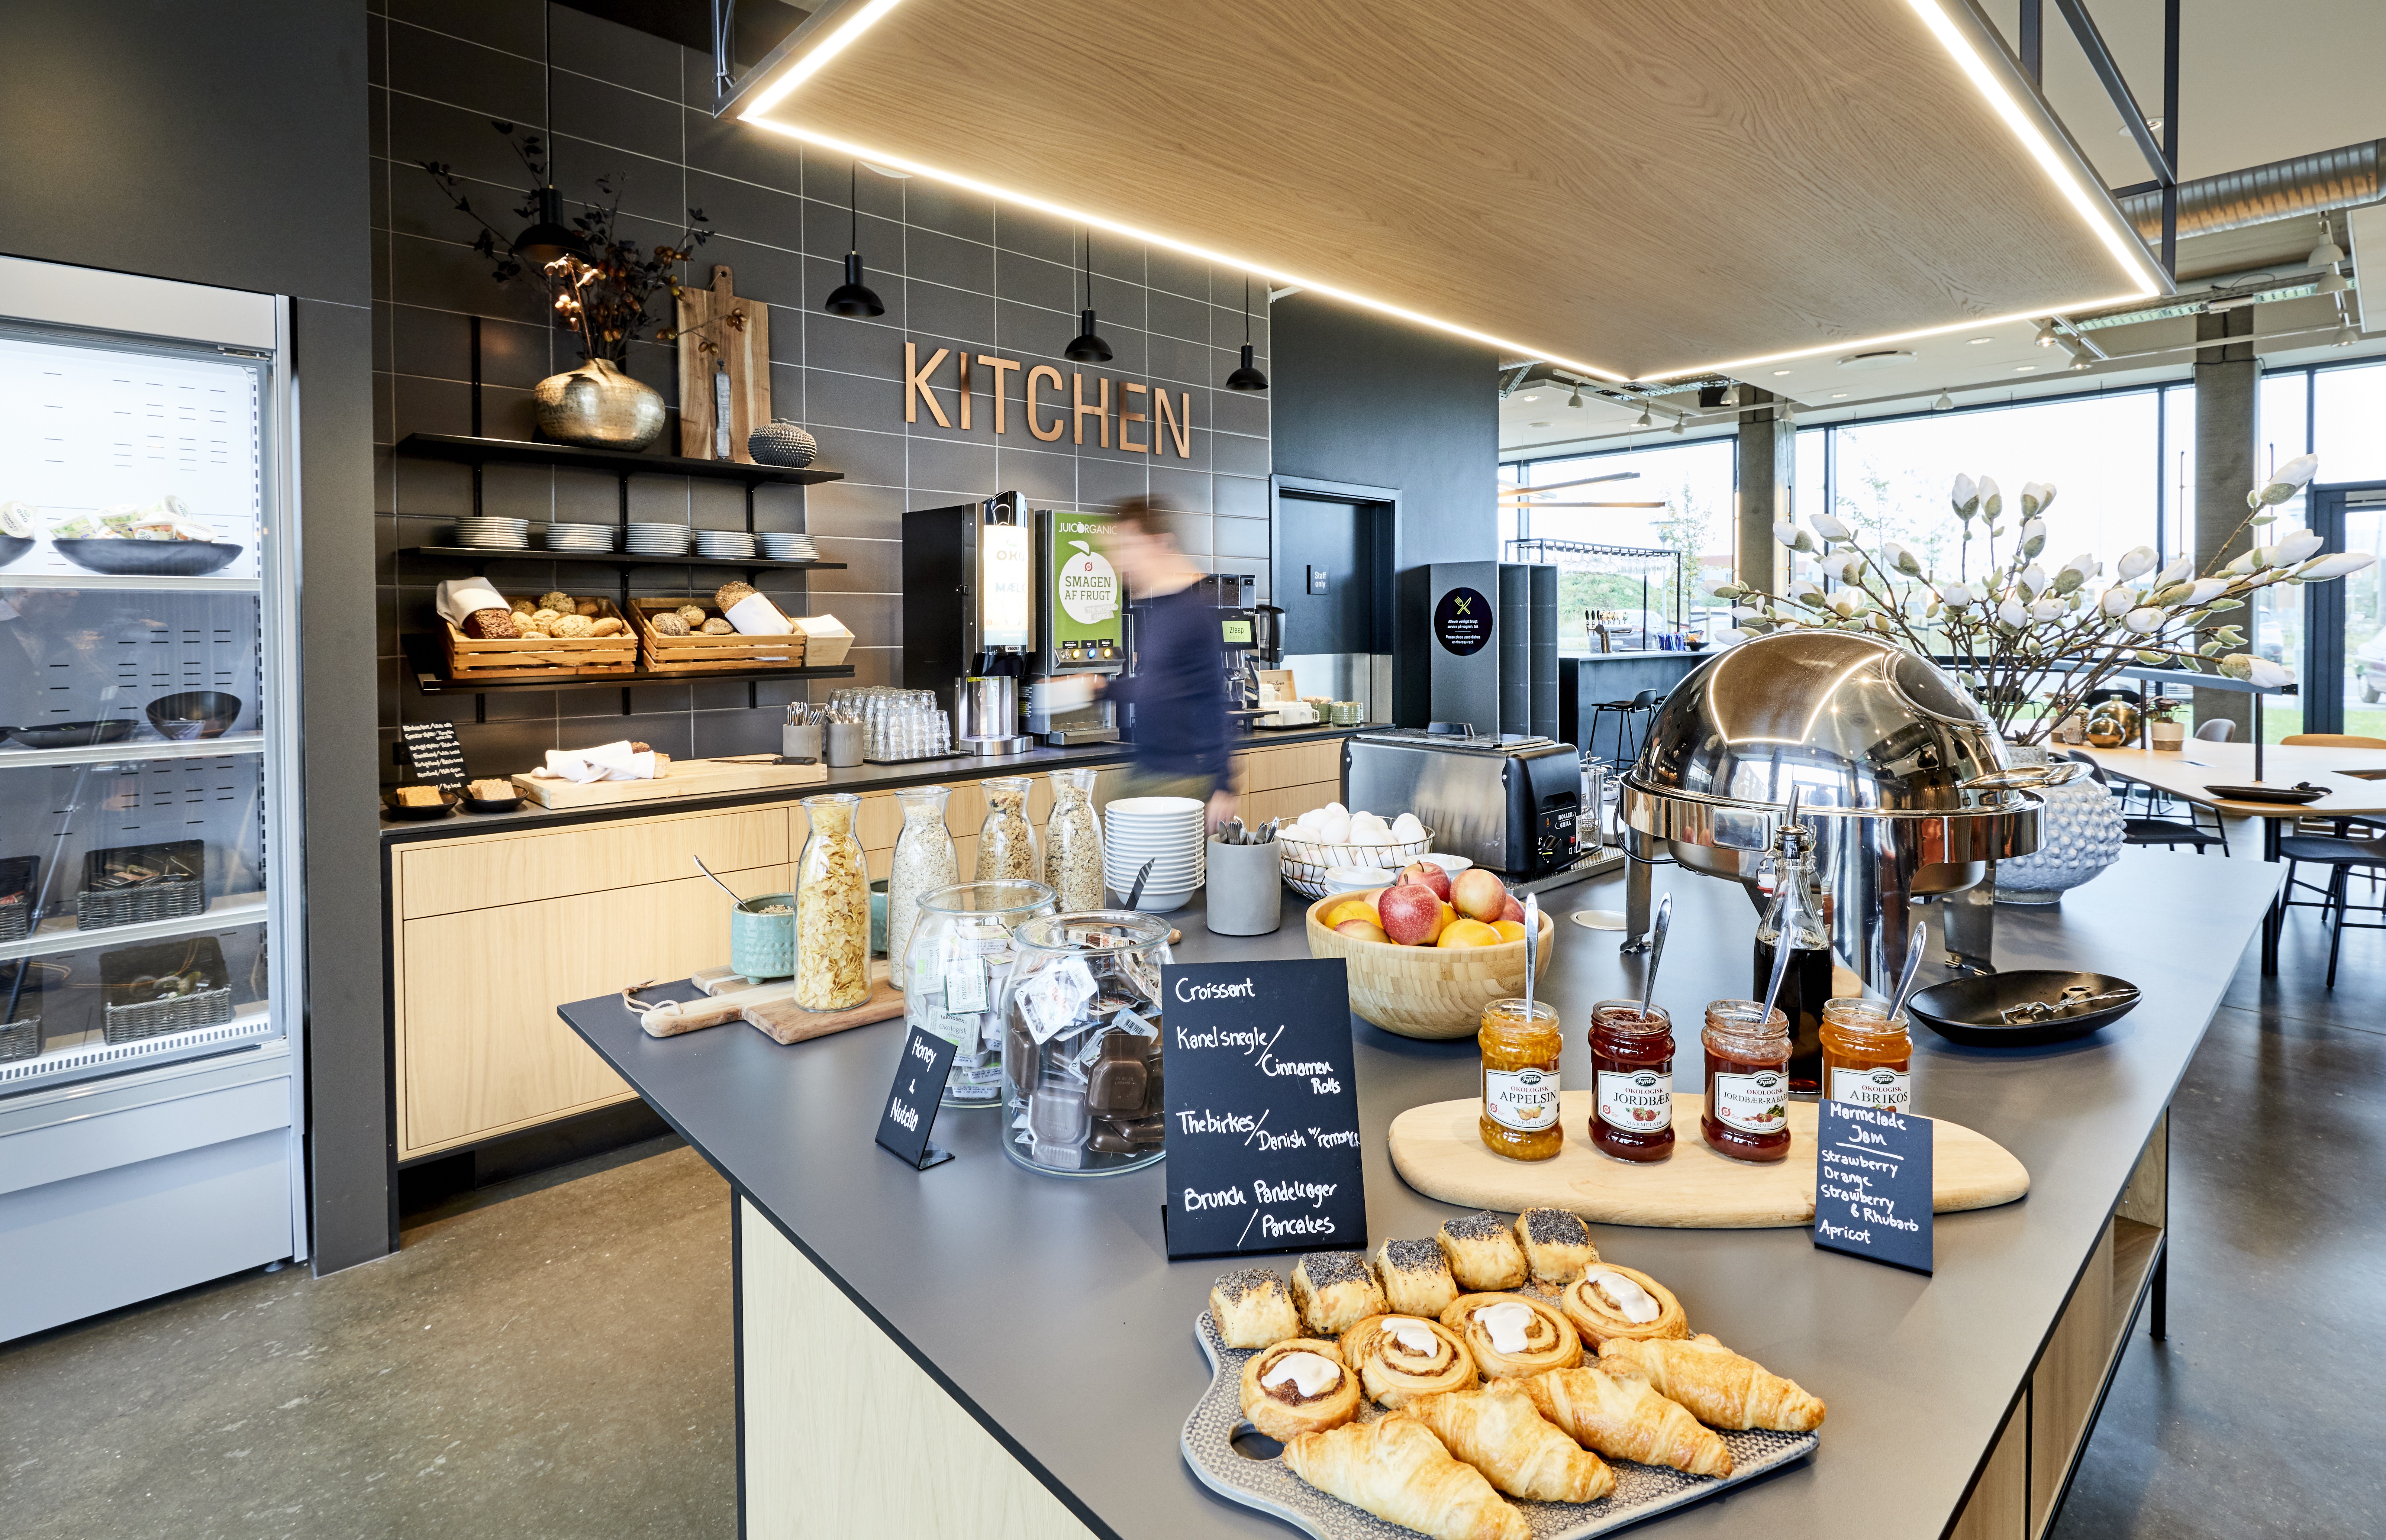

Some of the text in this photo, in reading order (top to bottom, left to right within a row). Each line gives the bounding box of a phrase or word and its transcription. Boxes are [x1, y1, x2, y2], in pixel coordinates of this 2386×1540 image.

[905, 342, 1190, 458] KITCHEN
[1065, 576, 1111, 588] SMAGEN
[1315, 571, 1326, 579] Staff
[1315, 579, 1326, 589] only
[1065, 590, 1111, 600] AF FRUGT
[1229, 626, 1244, 635] Zleep
[1558, 811, 1573, 821] ROLLER
[1560, 820, 1571, 828] GRILL
[1175, 977, 1256, 1003] Croissant
[941, 1014, 968, 1025] Jakobsens
[939, 1023, 967, 1034] Økologisk
[947, 1031, 965, 1042] Honning
[912, 1035, 937, 1072] Honey
[909, 1078, 915, 1094] &
[1310, 1077, 1341, 1094] Rolls
[1521, 1075, 1541, 1084] Fynbo
[1636, 1077, 1656, 1085] Fynbo
[1758, 1078, 1776, 1087] Fynbo
[1873, 1075, 1894, 1084] Fynbo
[1500, 1090, 1557, 1105] APPELSIN
[1613, 1092, 1670, 1106] JORDBÆR
[1850, 1090, 1908, 1104] ABRIKOS
[890, 1097, 919, 1131] Nutella
[1830, 1102, 1907, 1131] Marmelade
[1848, 1124, 1887, 1146] Jam
[1822, 1149, 1898, 1178] Strawberry
[1824, 1166, 1873, 1192] Orange
[1184, 1186, 1247, 1212] Brunch
[1821, 1184, 1895, 1214] Strawberry
[1262, 1214, 1335, 1238] Pancakes
[1863, 1207, 1919, 1231] Rhubarb
[1819, 1219, 1871, 1244] Apricot
